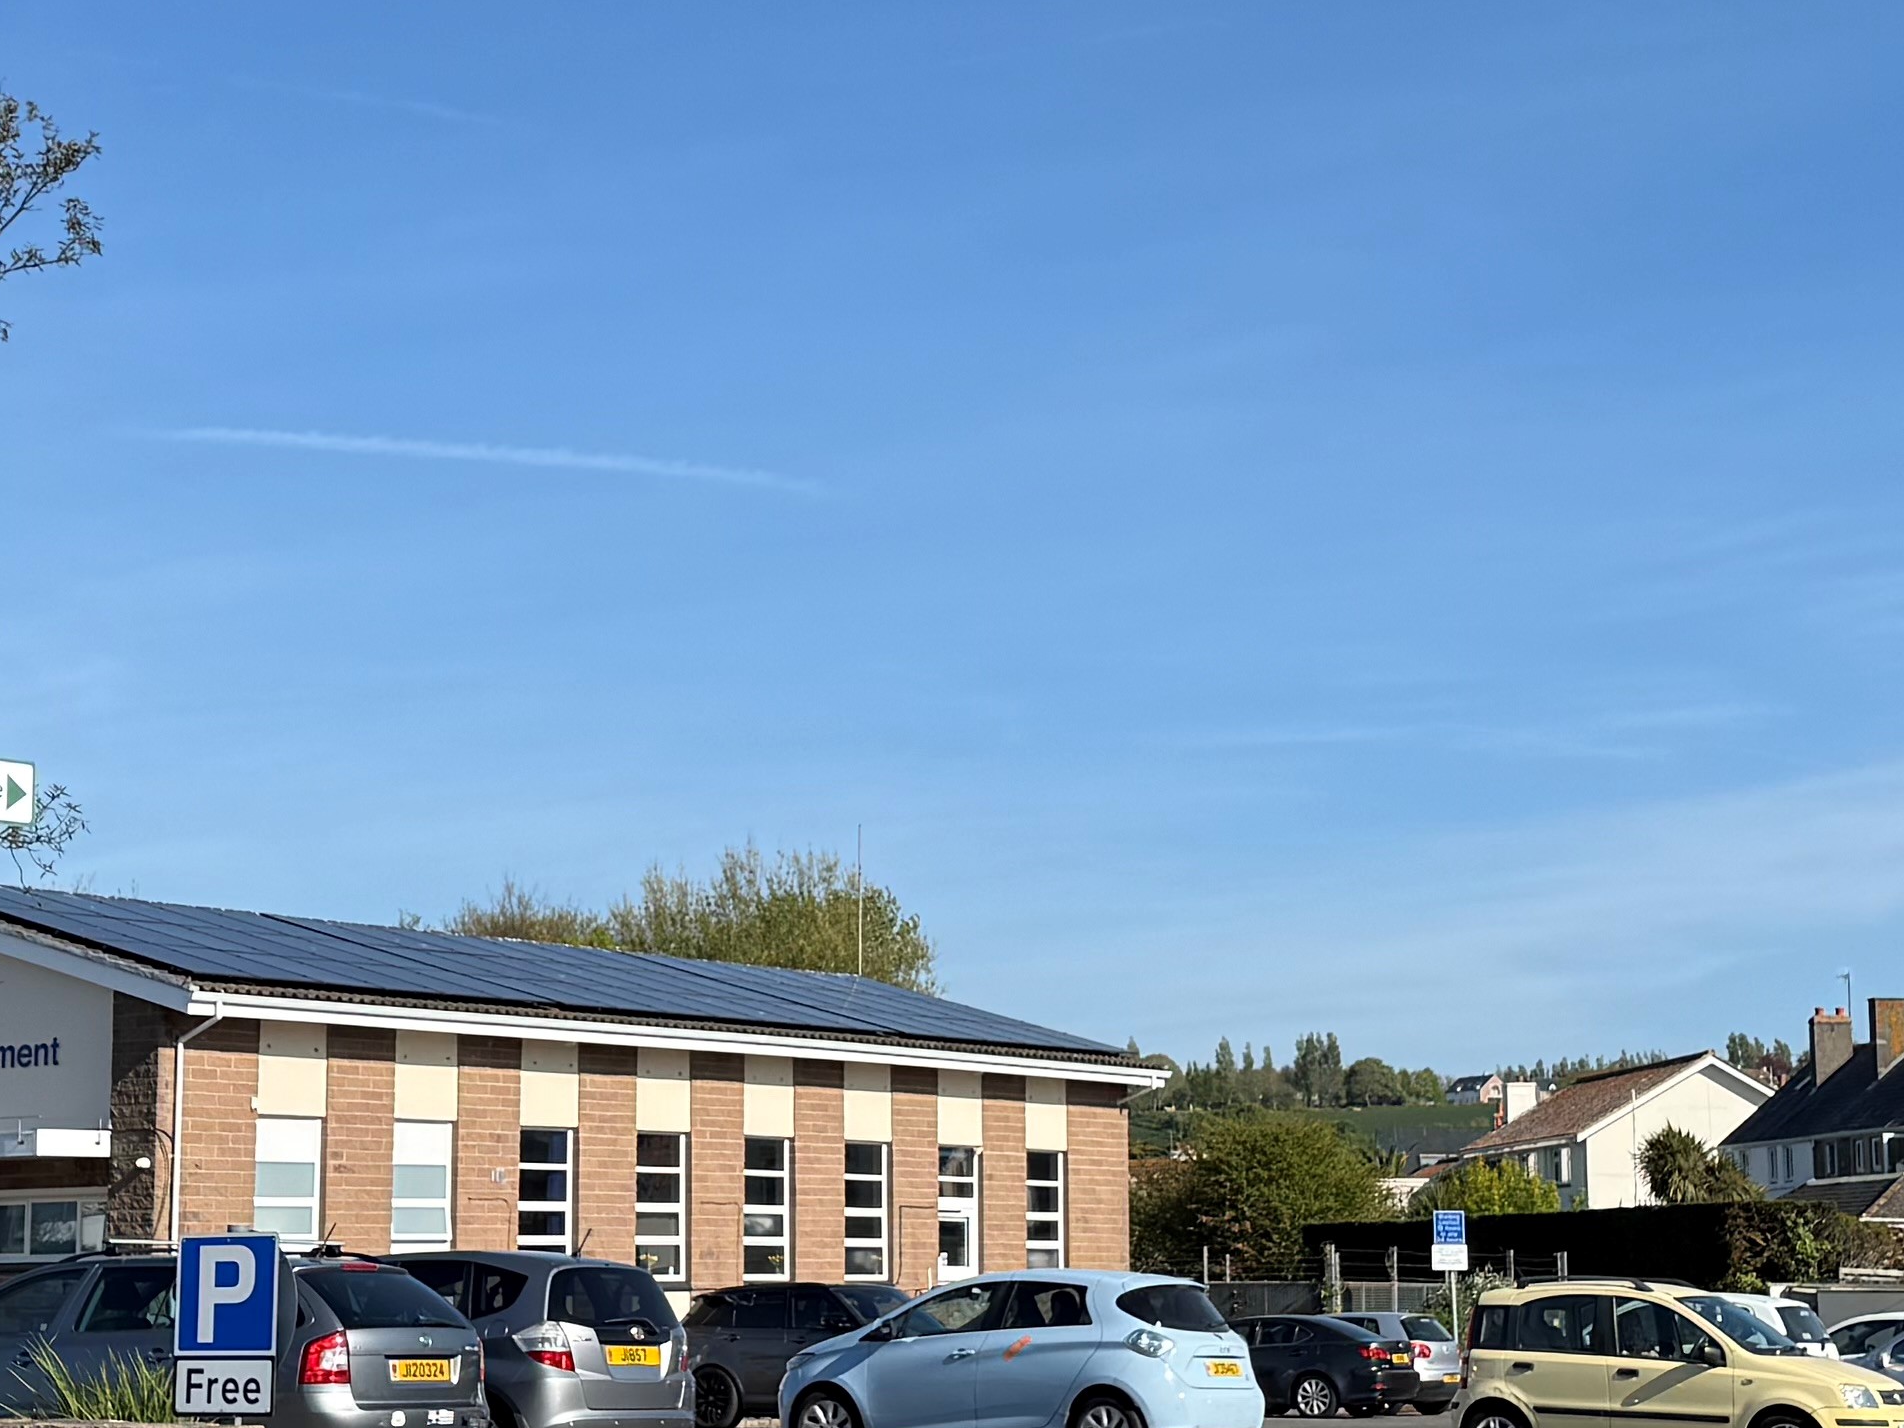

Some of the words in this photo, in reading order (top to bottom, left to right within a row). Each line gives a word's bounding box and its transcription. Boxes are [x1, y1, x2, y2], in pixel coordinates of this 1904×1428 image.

[197, 1244, 256, 1344] P
[185, 1368, 261, 1405] Free
[402, 1362, 445, 1378] J120324
